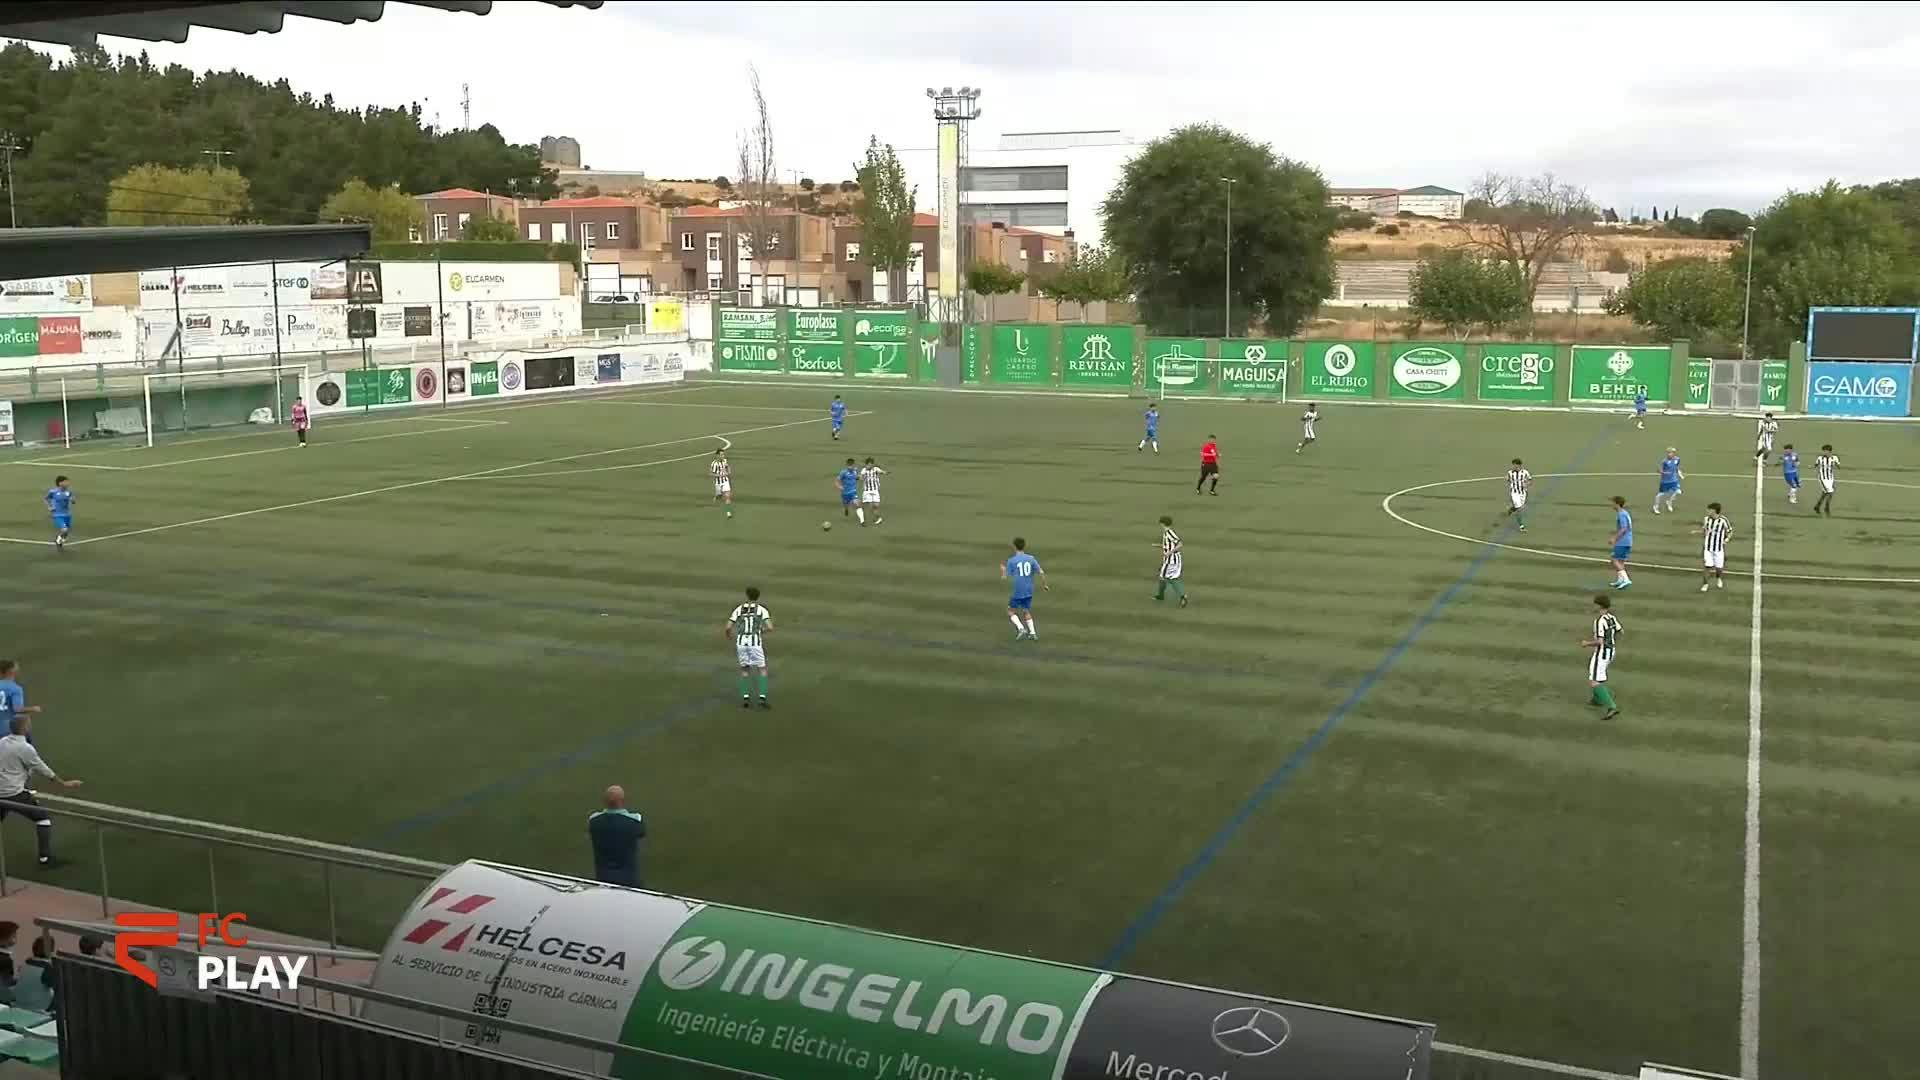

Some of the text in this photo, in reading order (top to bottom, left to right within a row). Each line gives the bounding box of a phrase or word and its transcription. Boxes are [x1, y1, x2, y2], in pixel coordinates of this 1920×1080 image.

[1069, 361, 1126, 371] REVISAN
[1223, 367, 1286, 382] MAGUISA
[1482, 354, 1554, 380] crego
[1311, 376, 1368, 388] EL RUBIO
[1814, 375, 1898, 396] GAMO
[1016, 561, 1032, 577] 10
[743, 616, 755, 634] 11
[476, 923, 627, 971] HELCESA
[391, 954, 405, 966] AL
[408, 957, 463, 979] SERVICIO
[465, 969, 481, 982] DE
[500, 976, 565, 1000] INDUSTRIA
[468, 946, 632, 987] FABRICAOS EN ACERO INOXIDABLE
[720, 949, 1064, 1055] INGELMO
[657, 1001, 767, 1046] Ingeniería
[771, 1023, 871, 1070] Eléctrica
[877, 1052, 894, 1077] y
